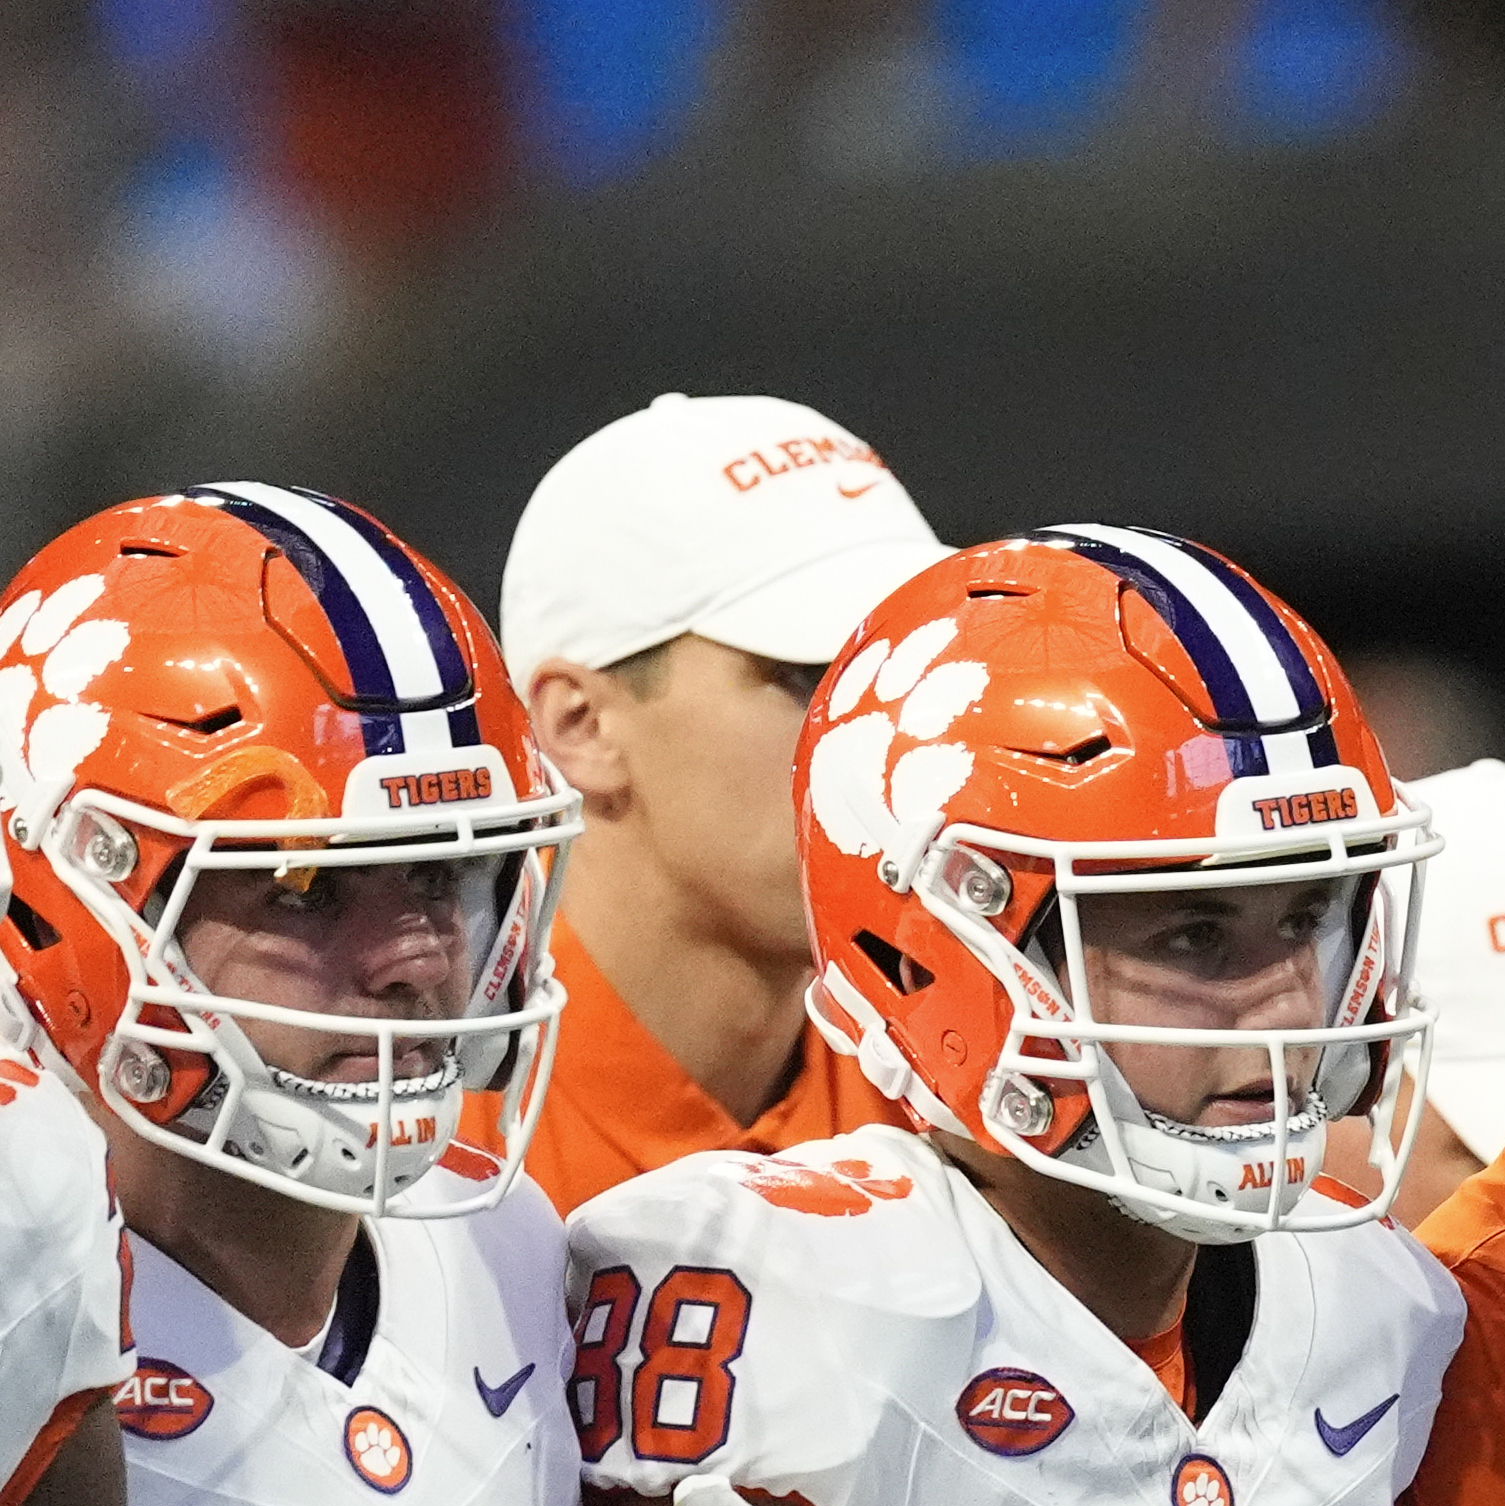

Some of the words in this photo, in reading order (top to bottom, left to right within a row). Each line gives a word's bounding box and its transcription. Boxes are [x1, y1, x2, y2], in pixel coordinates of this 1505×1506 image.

[379, 766, 492, 808] TIGERS
[1252, 787, 1358, 830] TIGERS
[1286, 1156, 1305, 1185] IN
[567, 1264, 753, 1466] 88
[113, 1377, 195, 1406] ACC
[968, 1387, 1058, 1422] ACC
